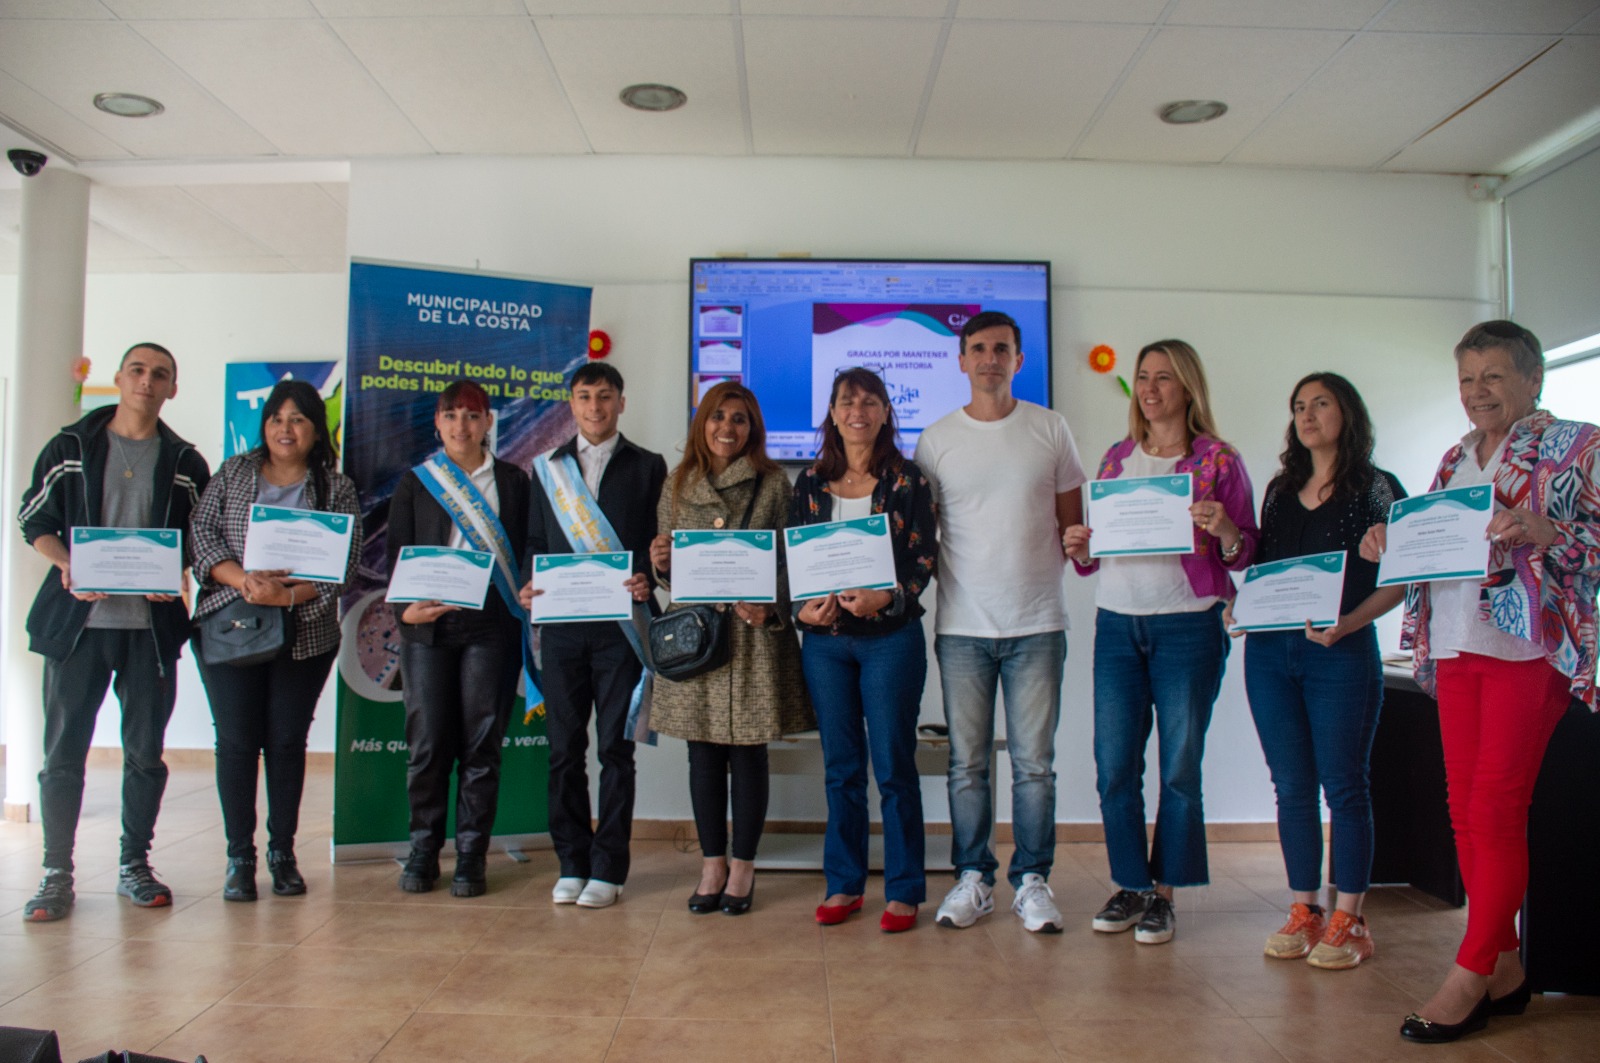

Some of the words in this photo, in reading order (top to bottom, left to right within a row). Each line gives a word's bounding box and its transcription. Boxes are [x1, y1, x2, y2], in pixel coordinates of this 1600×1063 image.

[407, 292, 542, 318] MUNICIPALIDAD
[418, 310, 442, 324] DE
[447, 312, 470, 326] LA
[475, 314, 531, 332] COSTA
[379, 355, 461, 376] Descubrí
[464, 362, 507, 379] todo
[510, 365, 527, 381] lo
[531, 370, 564, 385] que
[361, 373, 419, 391] podes
[504, 383, 525, 397] La
[529, 385, 571, 401] Cost
[350, 737, 383, 752] Más
